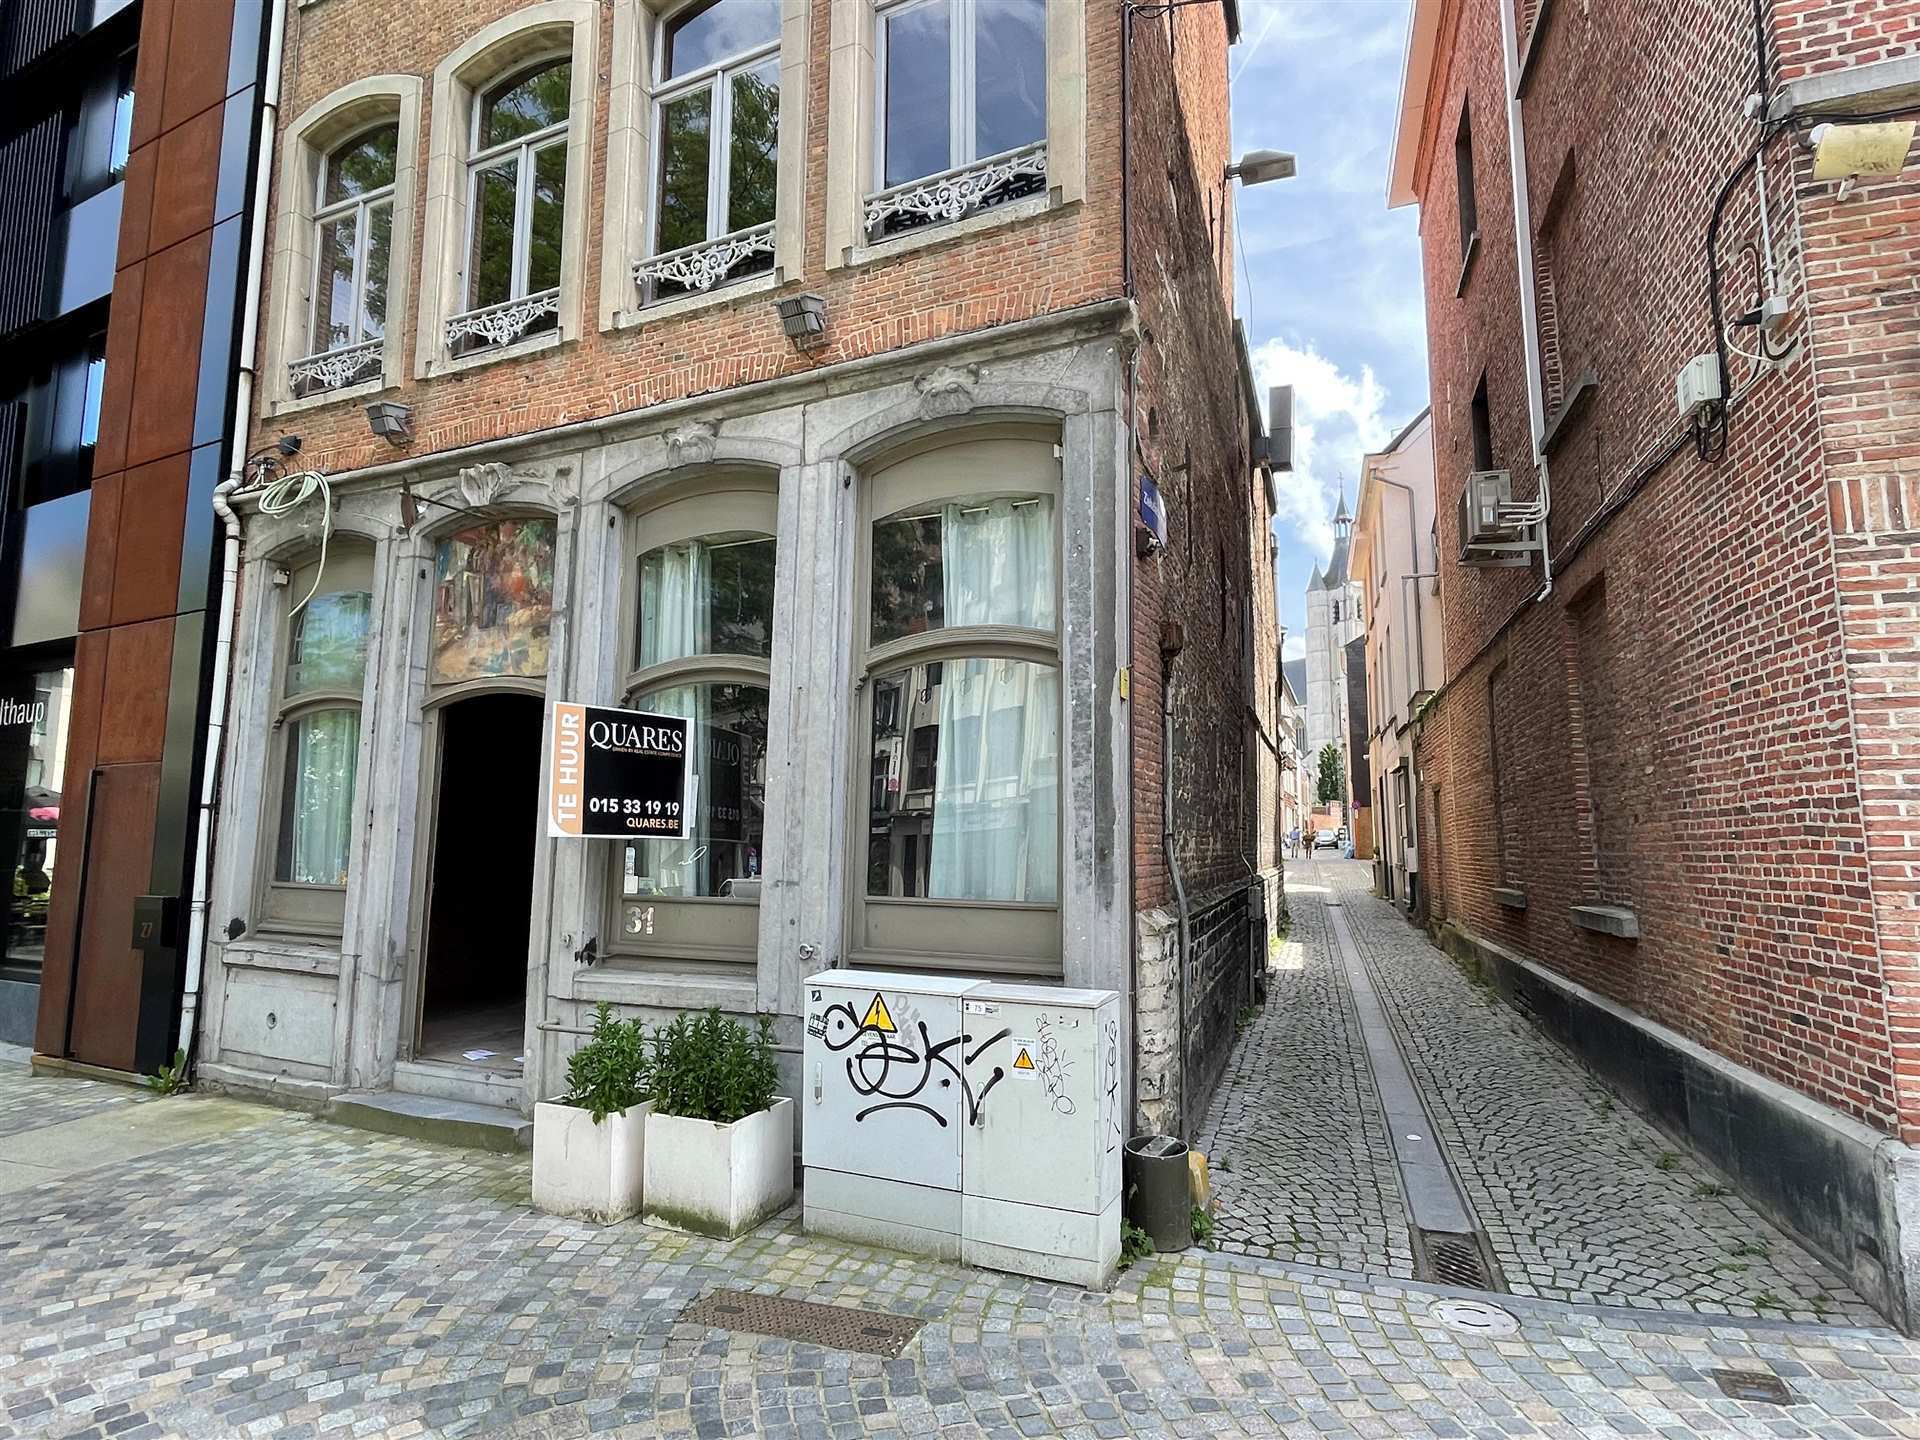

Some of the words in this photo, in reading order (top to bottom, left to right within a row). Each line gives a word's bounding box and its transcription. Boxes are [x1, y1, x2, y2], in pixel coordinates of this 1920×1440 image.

[559, 713, 580, 785] HUUR
[589, 721, 683, 752] QUARES
[558, 794, 577, 824] TE
[589, 798, 619, 813] 015
[622, 799, 641, 814] 33
[645, 800, 662, 815] 19
[665, 802, 680, 816] 19
[626, 817, 680, 829] QUARES.BE
[625, 906, 655, 935] 31
